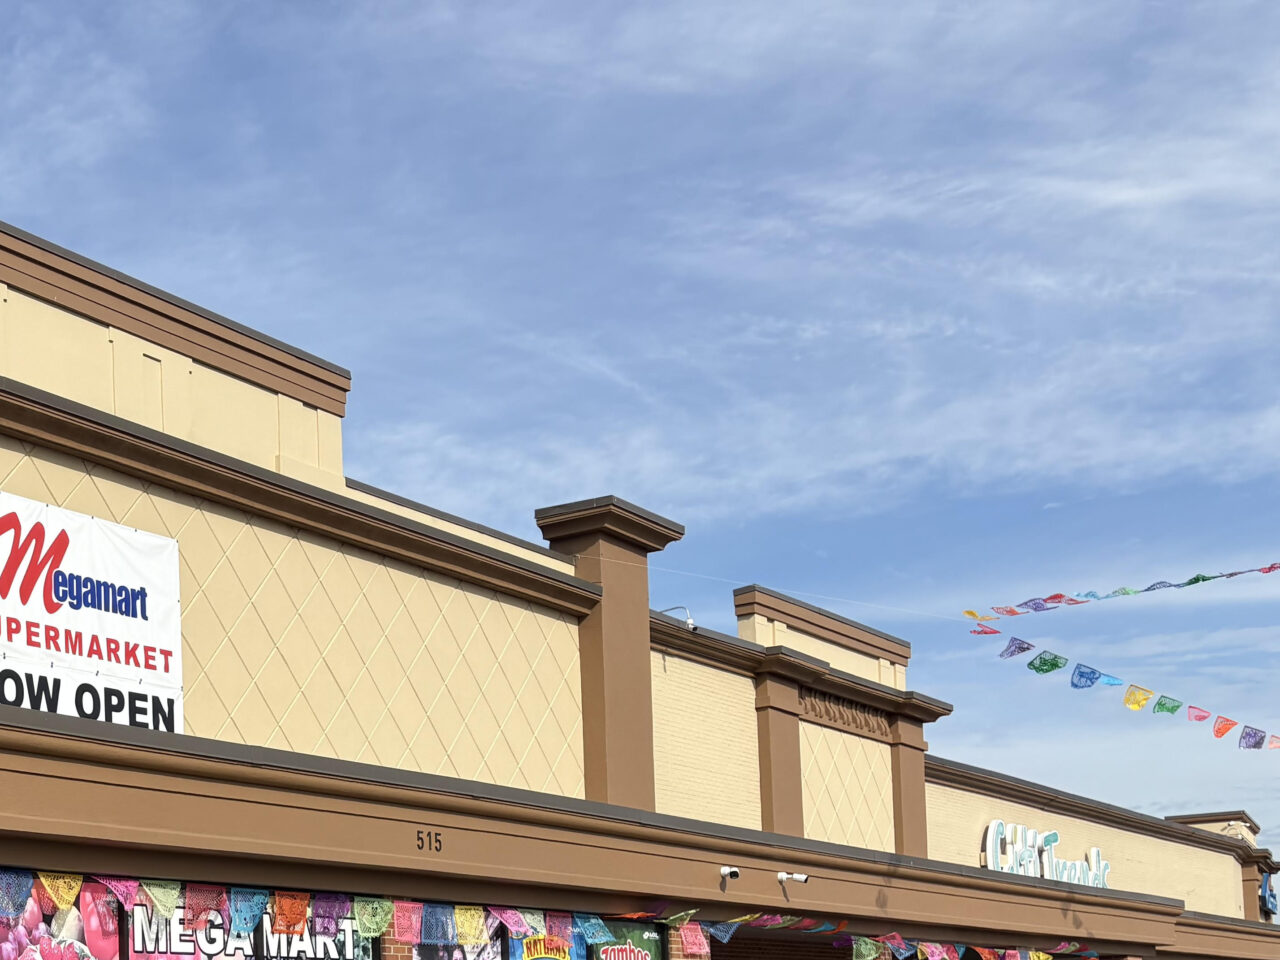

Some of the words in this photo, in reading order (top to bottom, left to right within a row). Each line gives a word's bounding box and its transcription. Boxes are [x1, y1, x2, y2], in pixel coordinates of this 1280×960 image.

[74, 682, 175, 734] OPEN
[416, 829, 442, 852] 515
[132, 904, 254, 957] MEGA
[262, 912, 357, 960] MART
